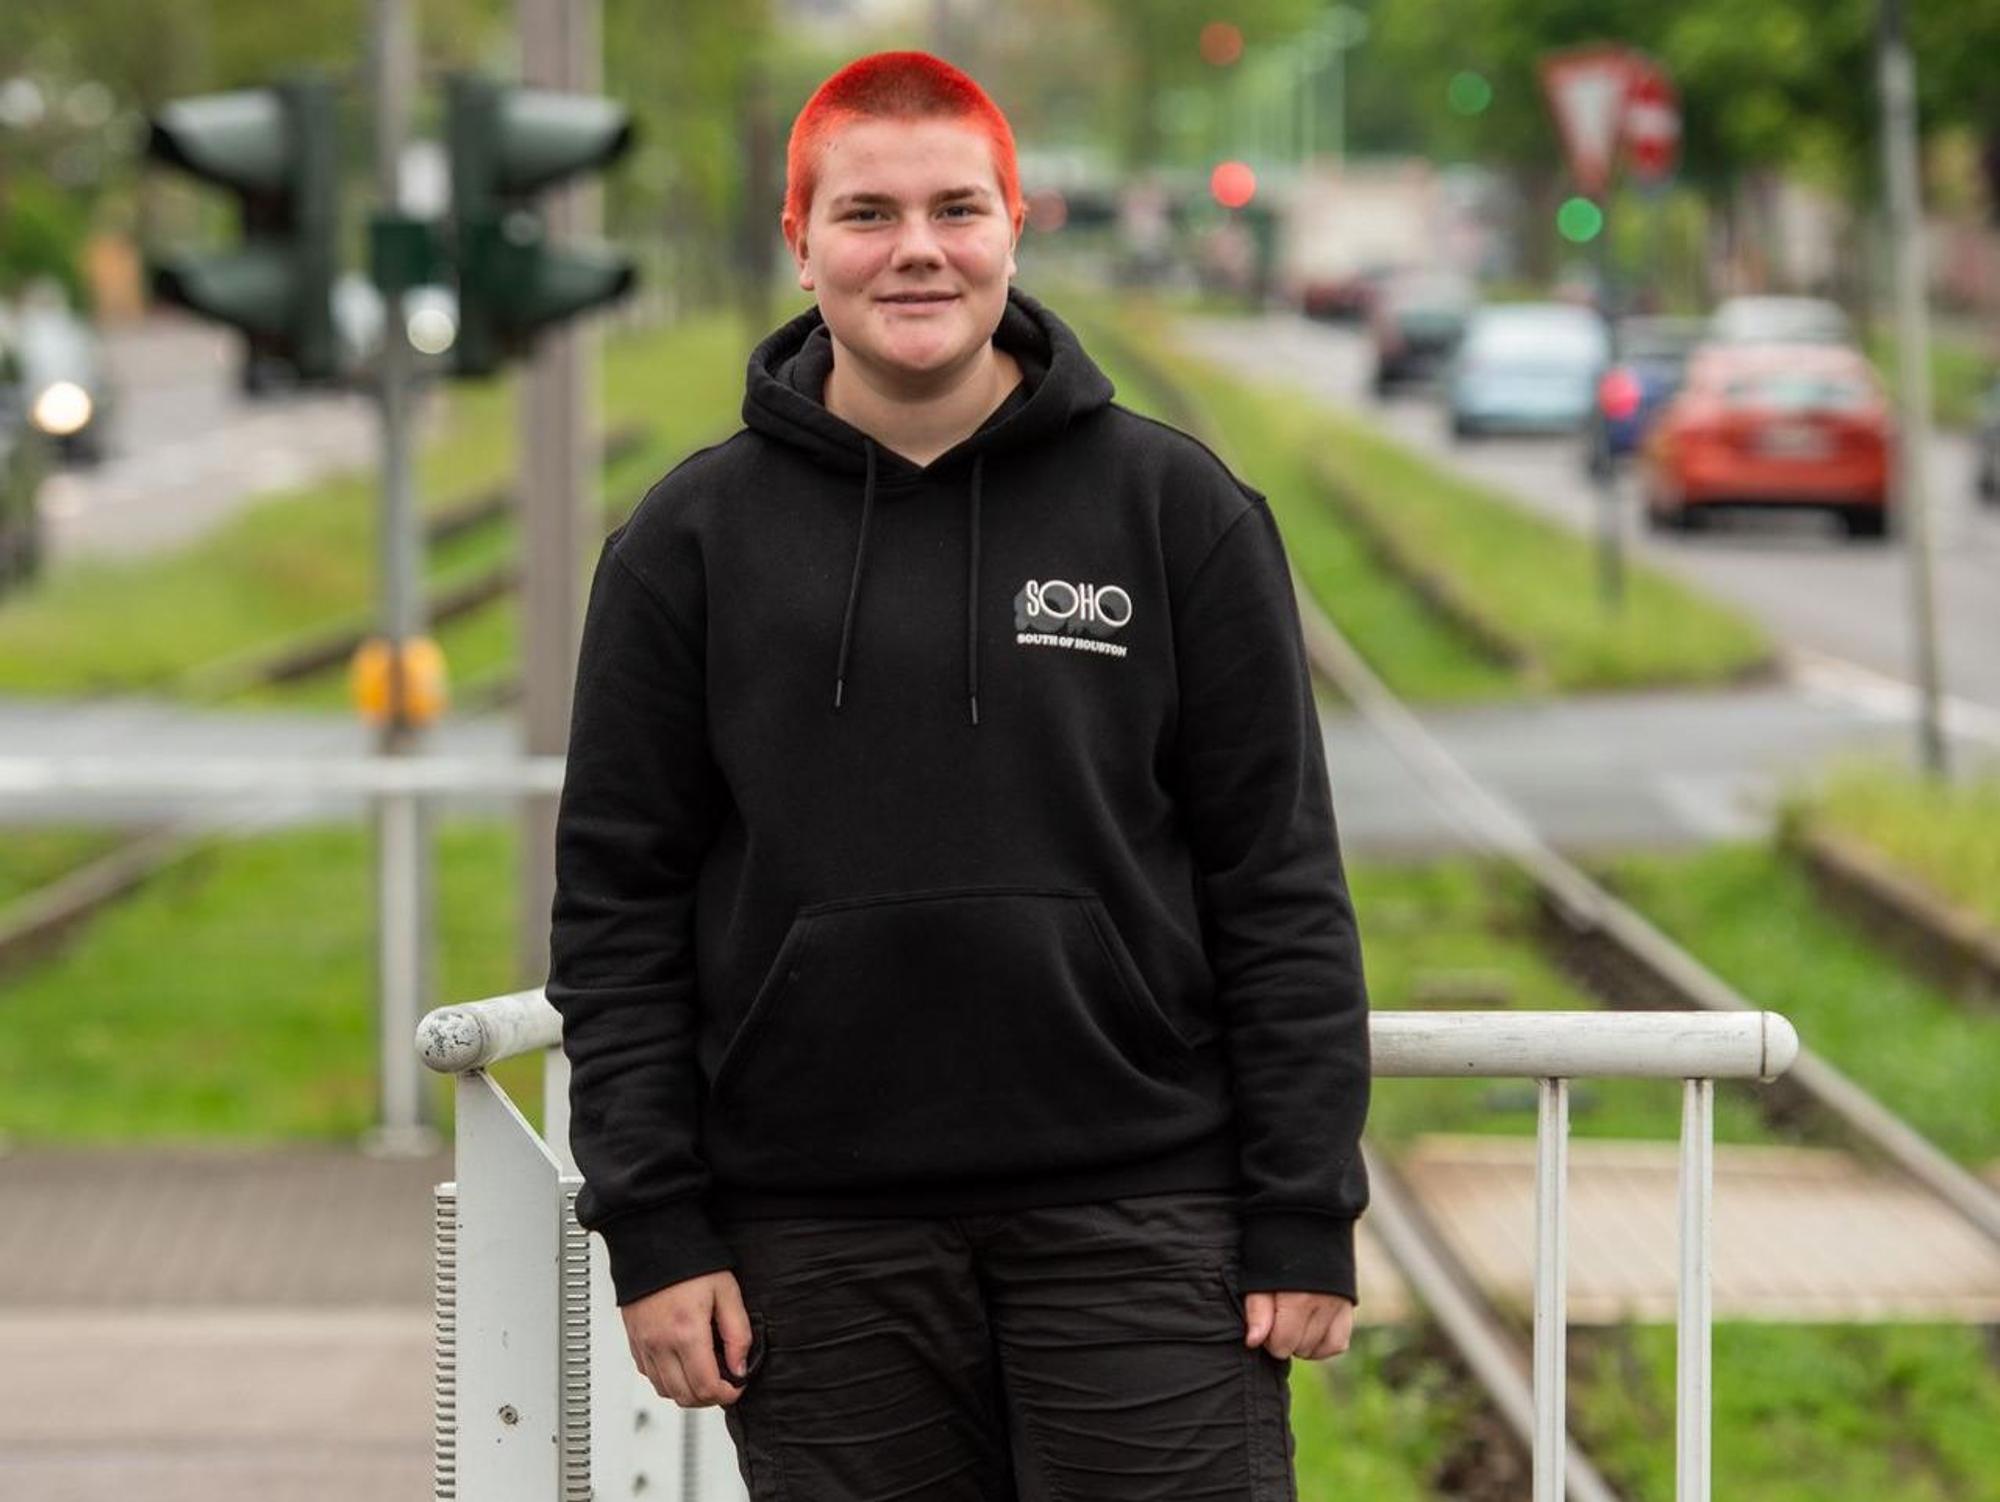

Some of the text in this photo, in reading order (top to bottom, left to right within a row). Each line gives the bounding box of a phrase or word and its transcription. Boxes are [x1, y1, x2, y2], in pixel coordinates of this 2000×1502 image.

[1026, 579, 1132, 627] SOHO
[1017, 633, 1127, 657] SOUTH OF HOUSTON
